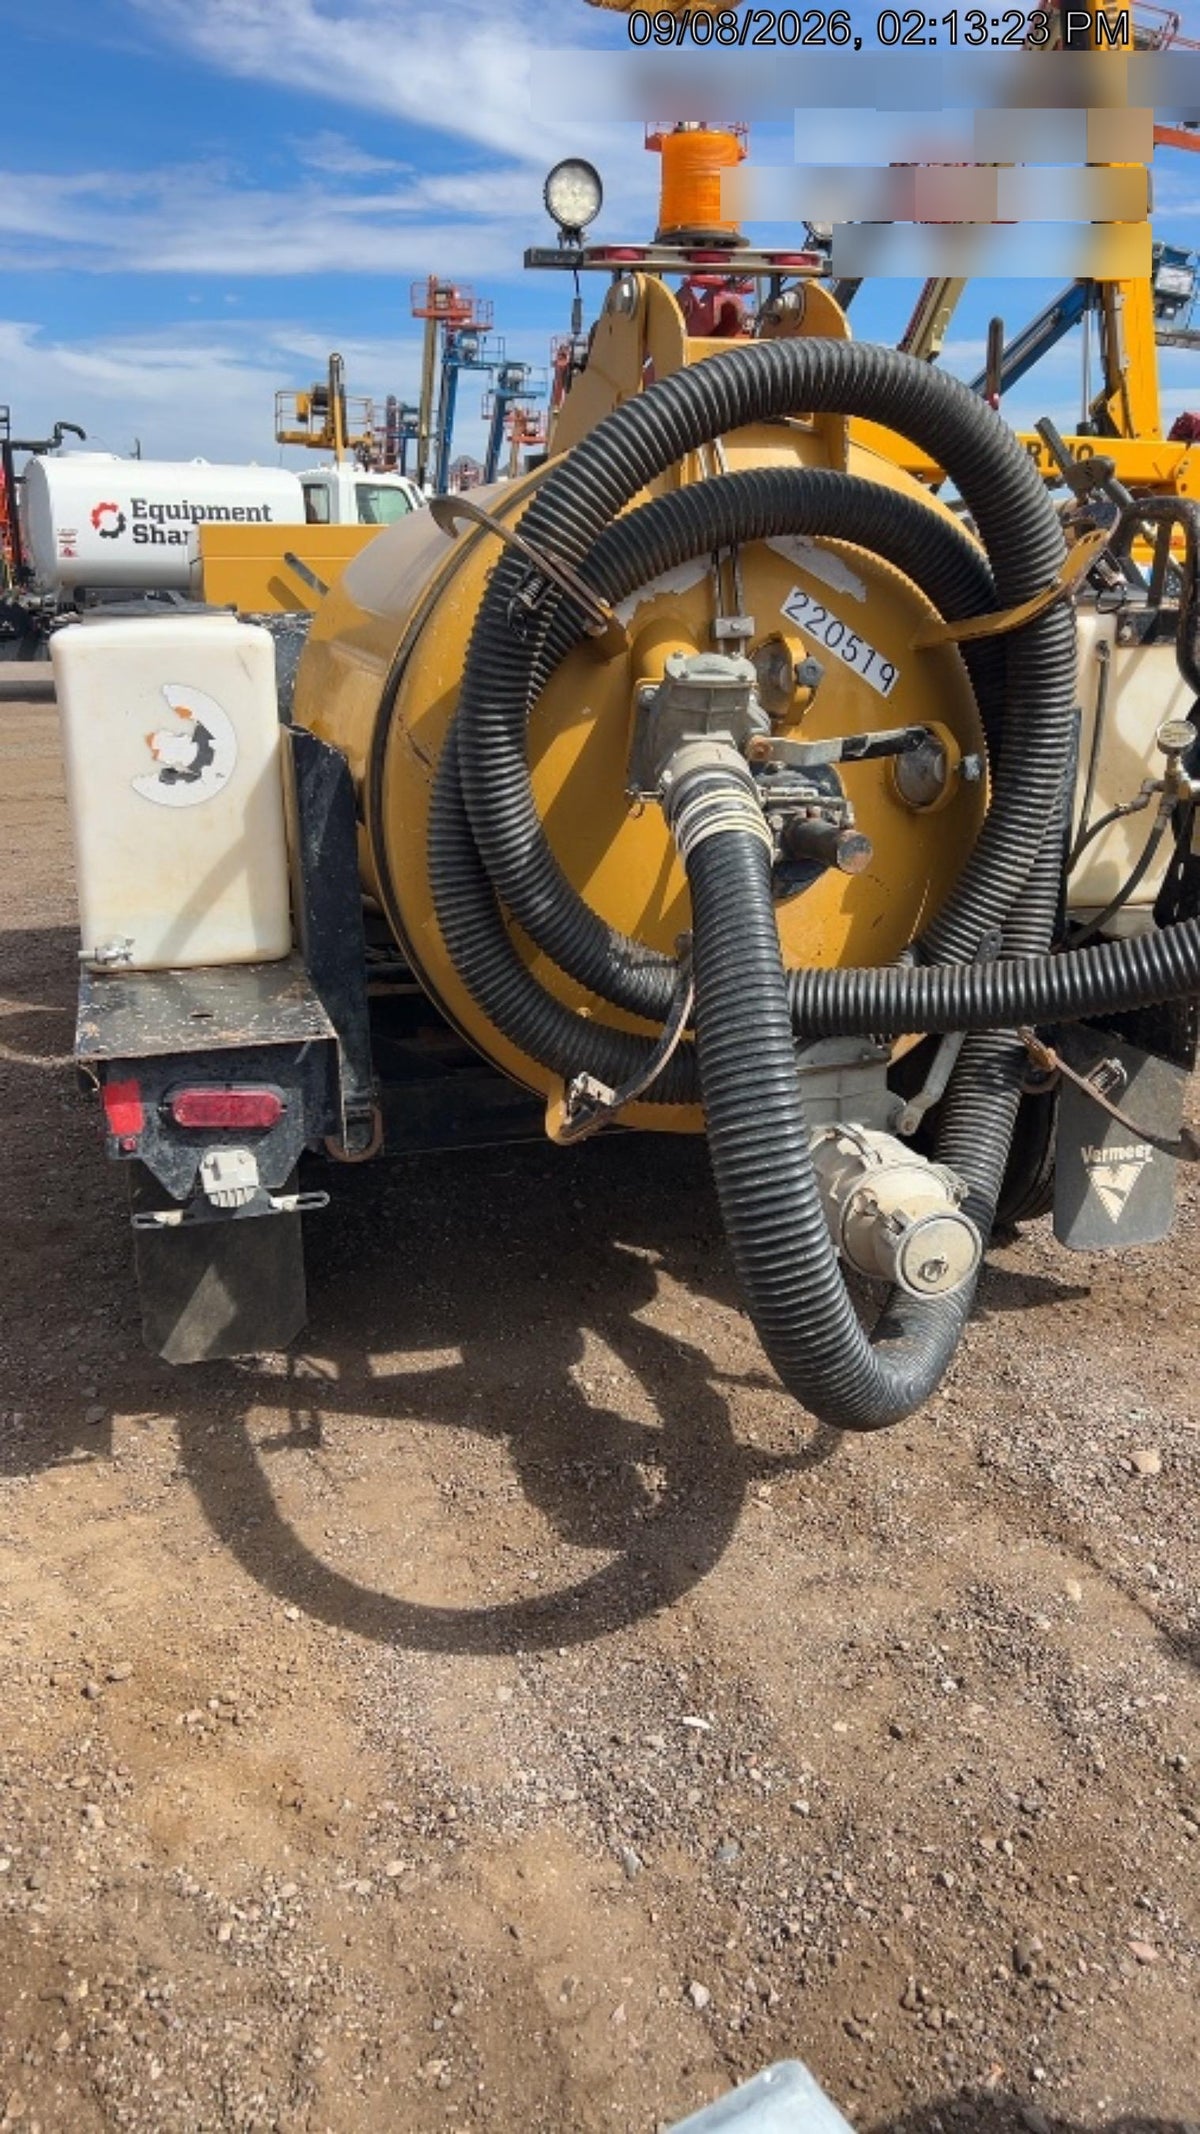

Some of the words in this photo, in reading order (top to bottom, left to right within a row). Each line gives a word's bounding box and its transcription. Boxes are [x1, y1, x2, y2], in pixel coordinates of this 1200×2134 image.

[130, 498, 273, 525] Equipment
[785, 592, 895, 693] 220519
[1081, 1145, 1154, 1163] Vermeer
